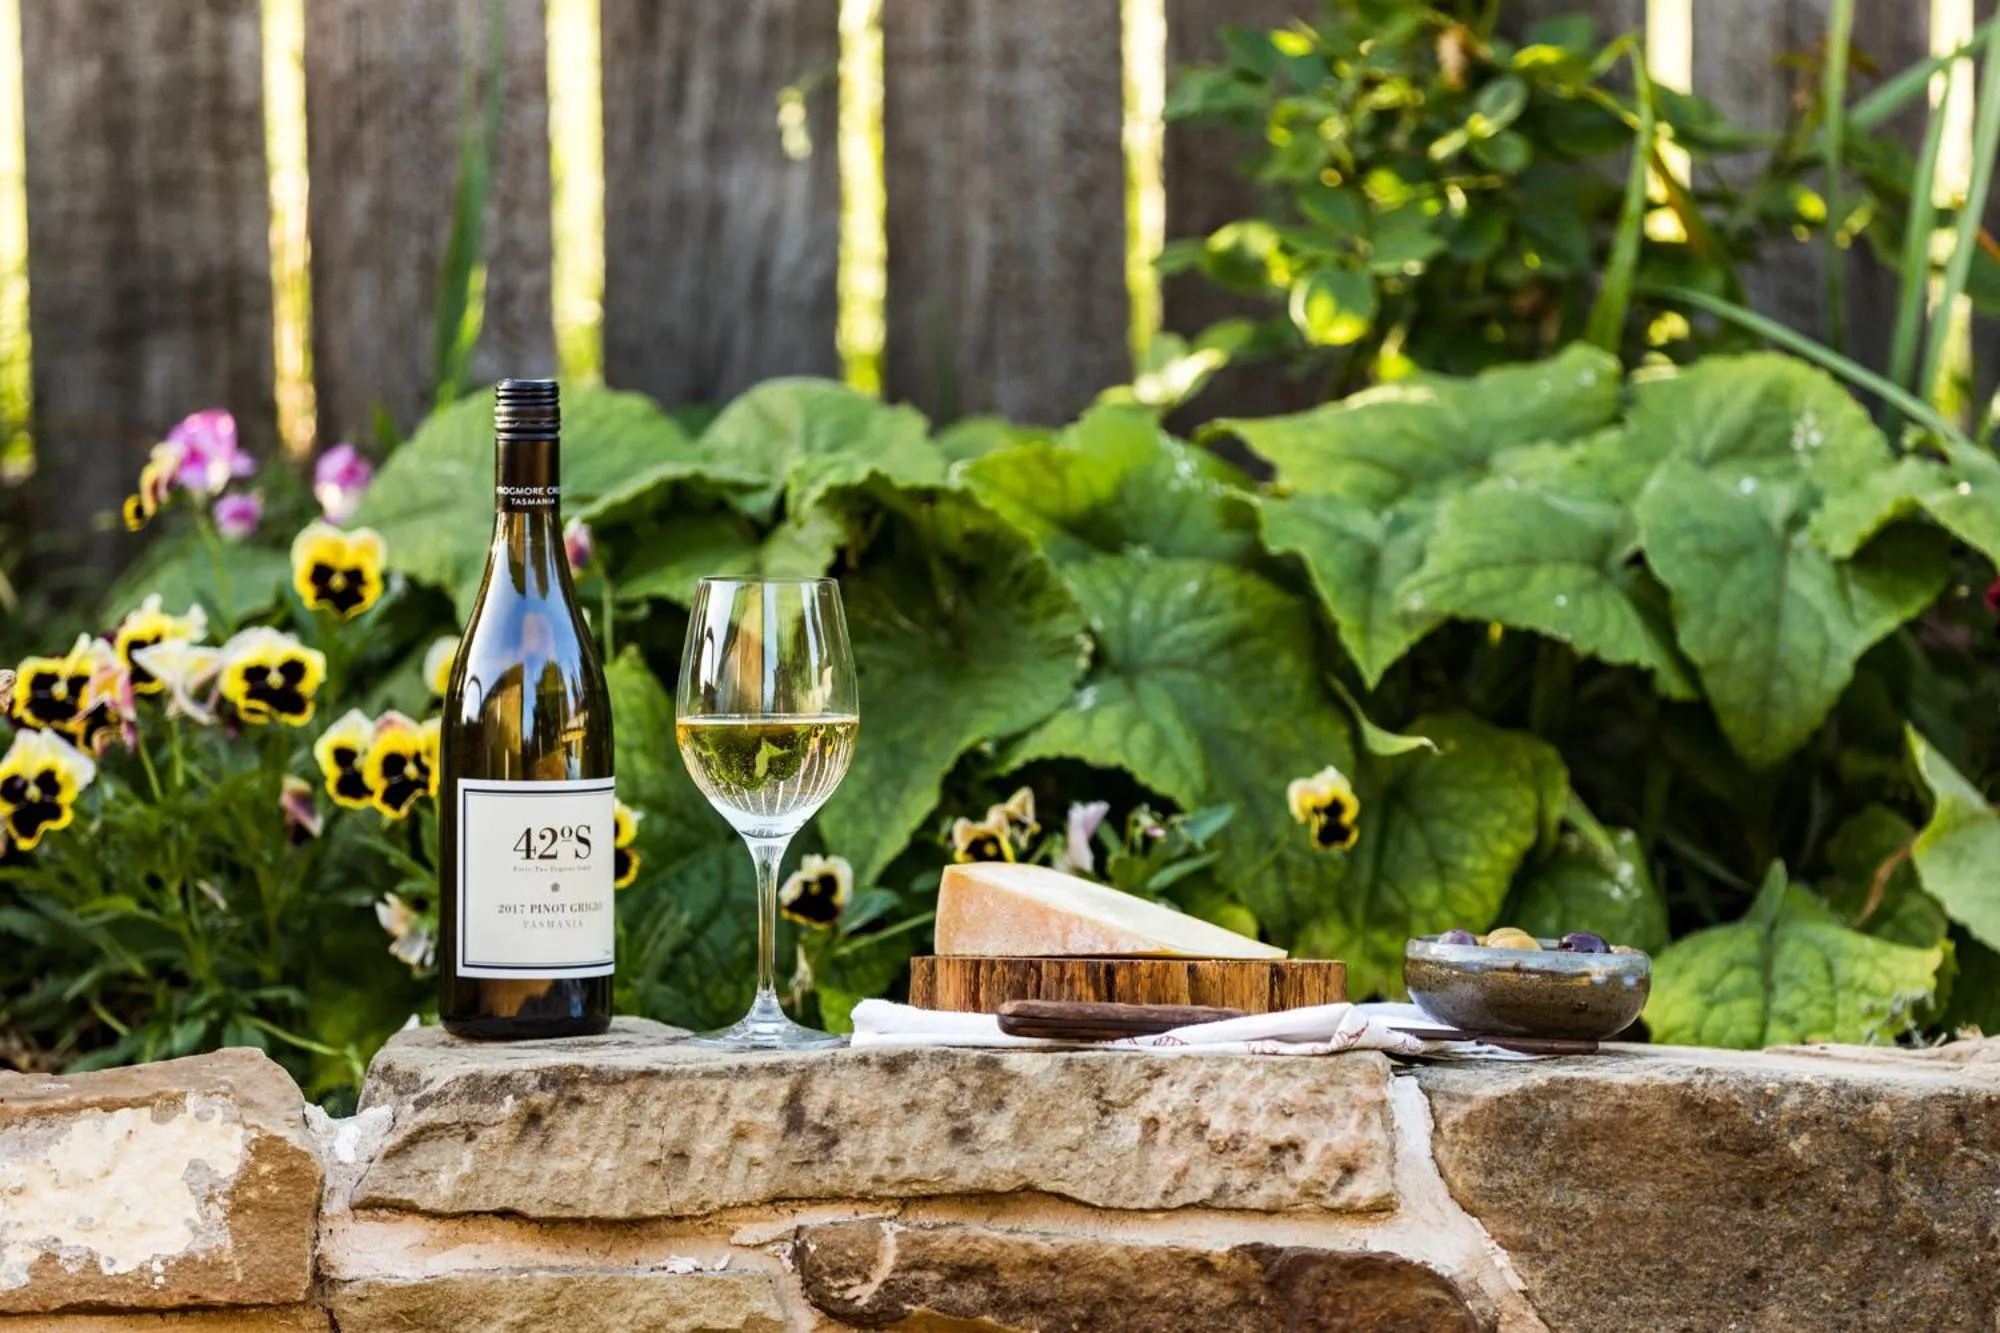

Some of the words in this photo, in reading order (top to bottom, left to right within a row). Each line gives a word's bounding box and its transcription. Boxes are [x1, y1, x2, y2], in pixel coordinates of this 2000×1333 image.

[510, 497, 555, 505] TASMANIA
[498, 903, 525, 914] 2017
[530, 903, 567, 914] PINOT
[523, 919, 583, 929] TASMANIA
